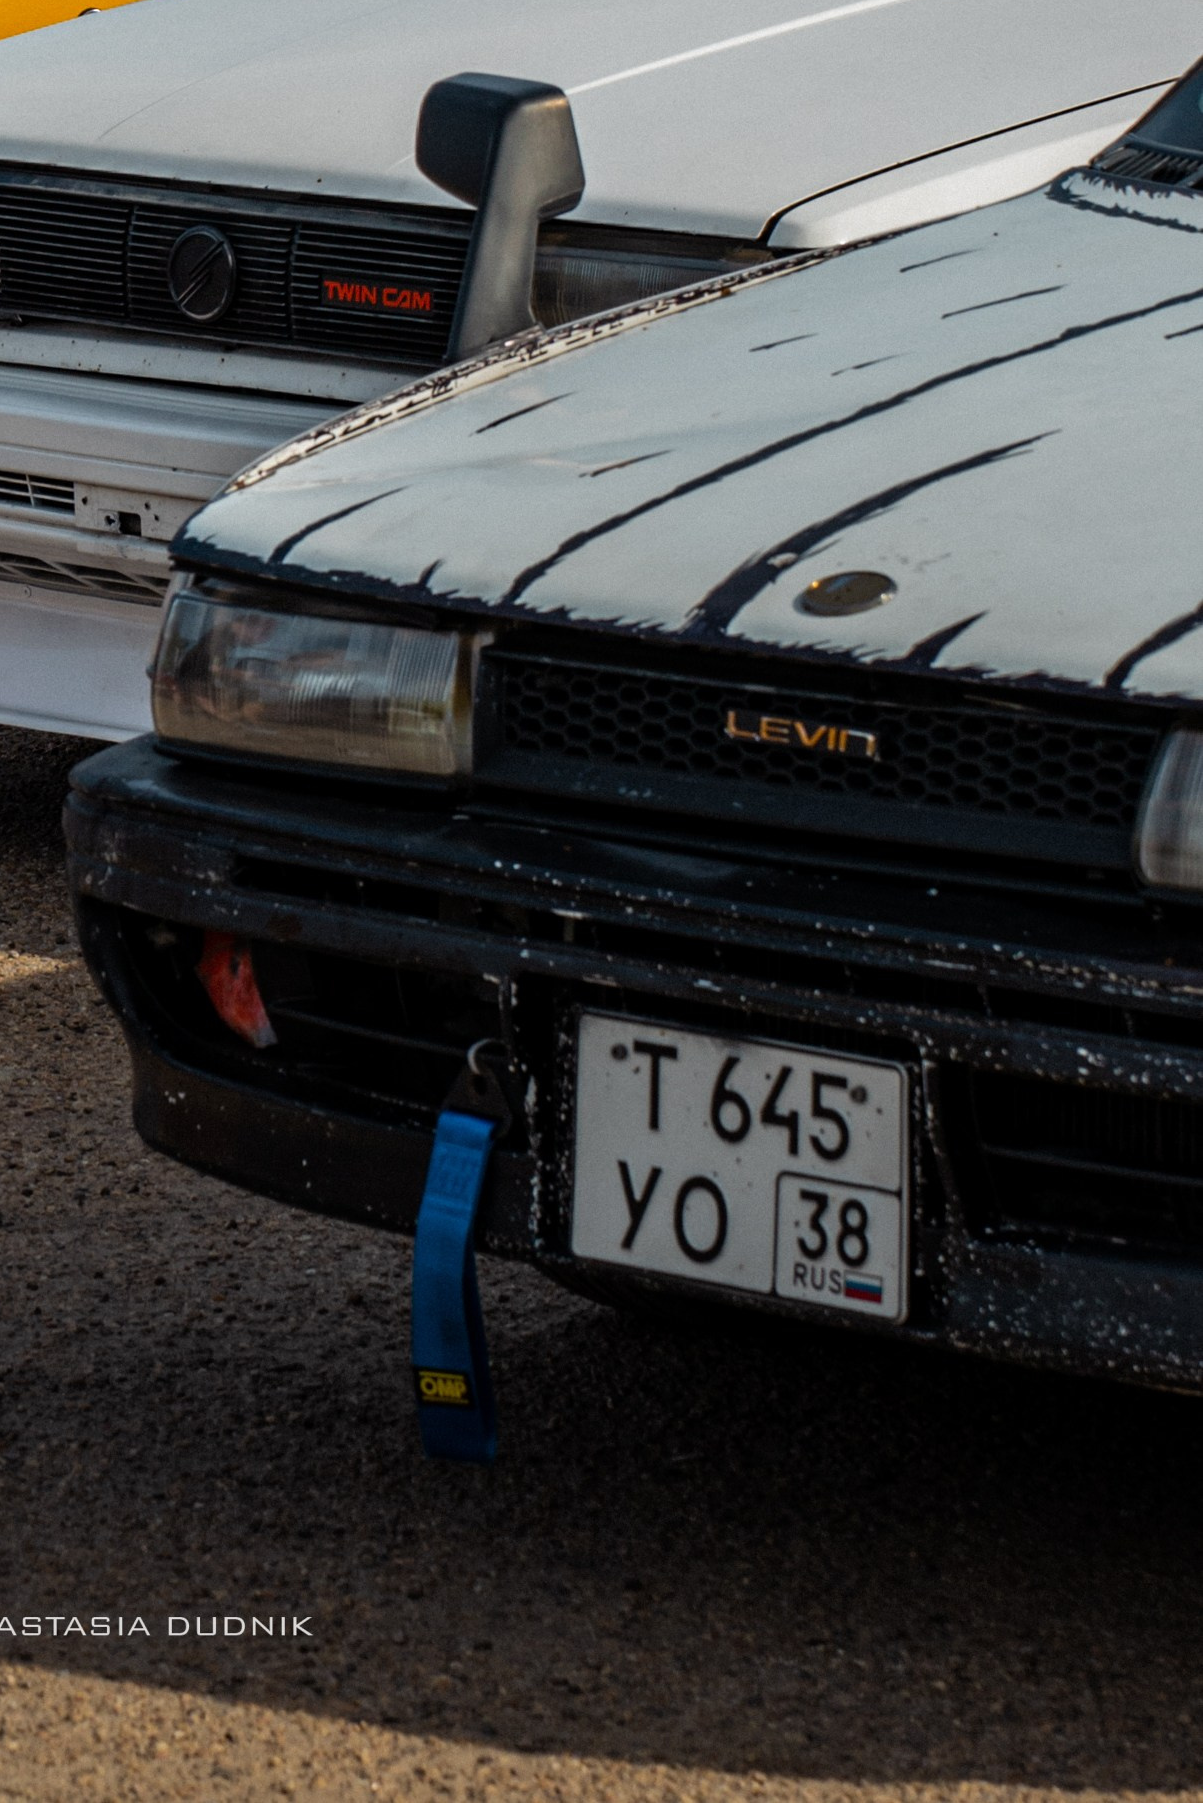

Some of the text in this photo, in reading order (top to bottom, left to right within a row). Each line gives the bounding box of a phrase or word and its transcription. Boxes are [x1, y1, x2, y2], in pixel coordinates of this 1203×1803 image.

[323, 280, 431, 311] TWIN CAM
[711, 1055, 850, 1163] 645
[797, 1188, 870, 1268] 38
[793, 1262, 843, 1295] RUS
[420, 1376, 467, 1399] OMP
